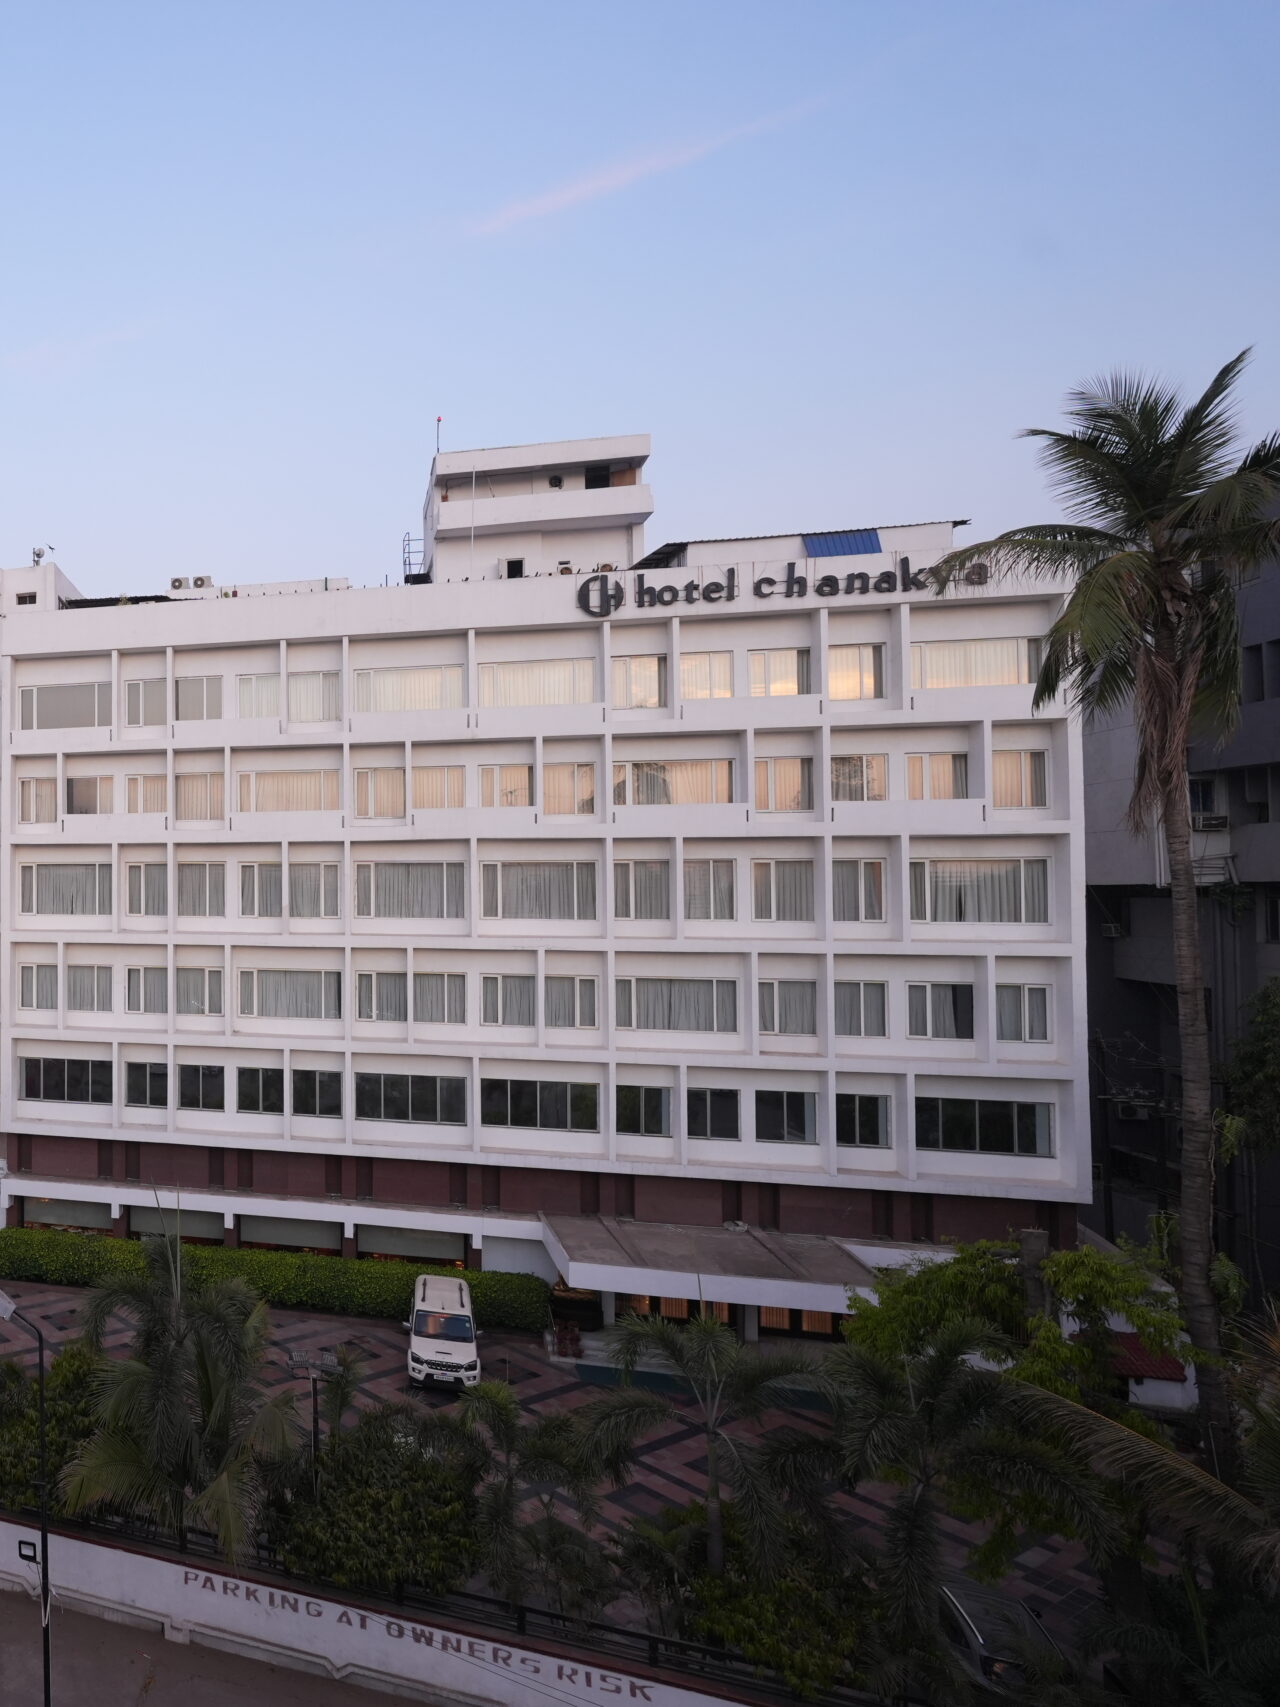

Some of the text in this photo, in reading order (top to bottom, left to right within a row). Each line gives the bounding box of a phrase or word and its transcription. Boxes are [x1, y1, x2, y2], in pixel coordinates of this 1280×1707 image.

[637, 567, 736, 608] hotel
[184, 1570, 655, 1702] PARKING AT OWNERS RISK
